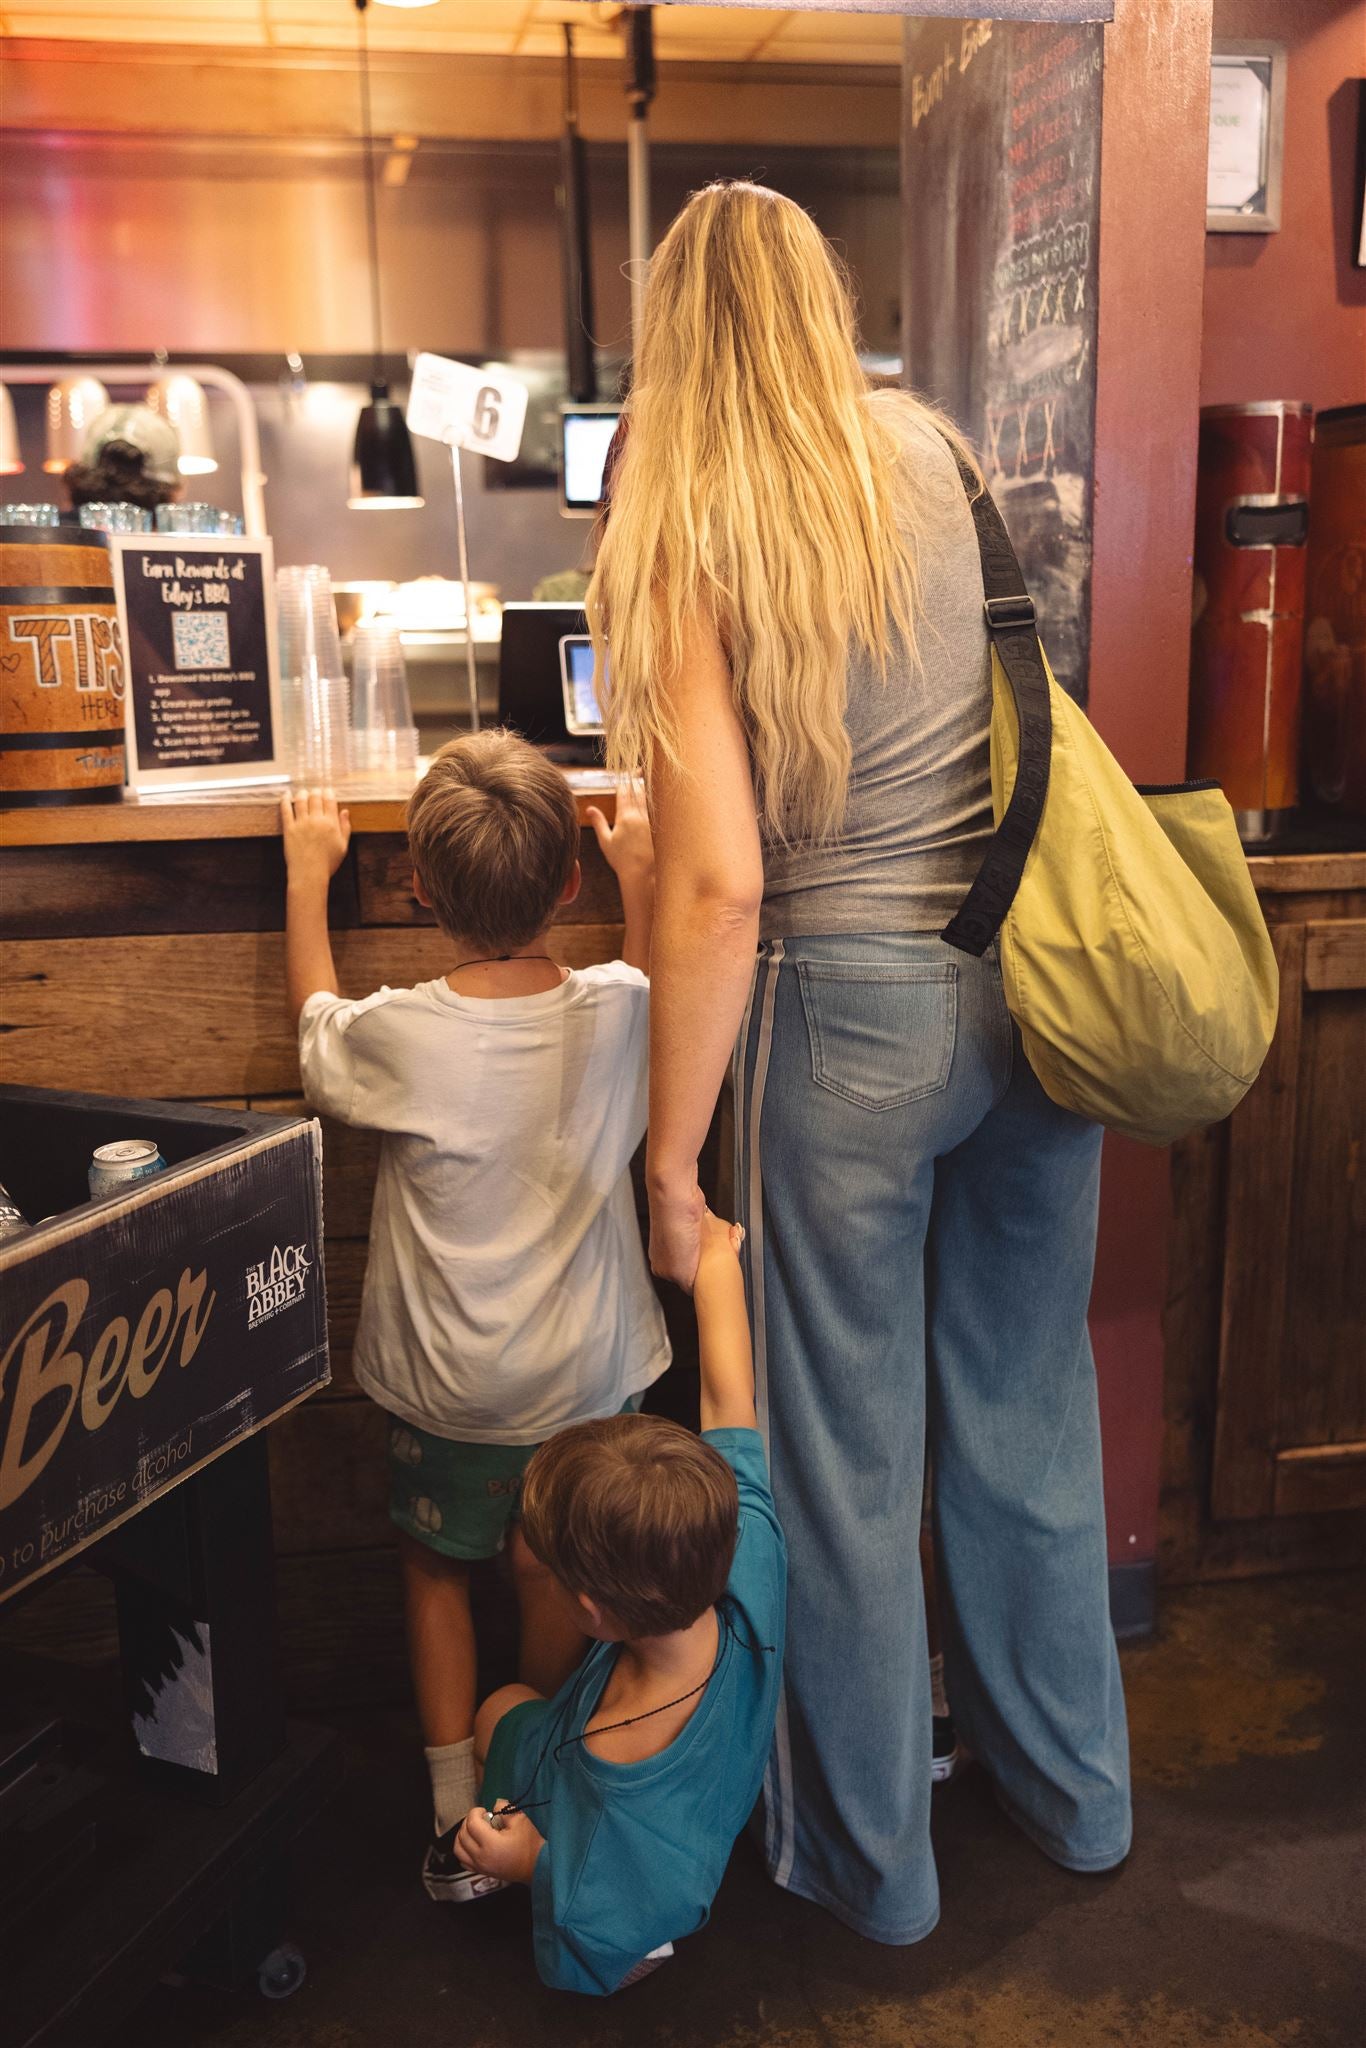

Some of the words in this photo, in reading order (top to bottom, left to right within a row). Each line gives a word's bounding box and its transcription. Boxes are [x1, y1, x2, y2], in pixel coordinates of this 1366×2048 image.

[473, 386, 502, 440] 6
[142, 556, 174, 579] Earn
[175, 557, 230, 580] Rewards
[8, 614, 126, 700] TIPS
[245, 1243, 313, 1300] BLACK
[247, 1267, 307, 1323] ABBEY
[0, 1267, 216, 1510] Beer
[13, 1543, 34, 1568] to
[40, 1481, 127, 1560] purchase
[131, 1428, 193, 1492] alcohol
